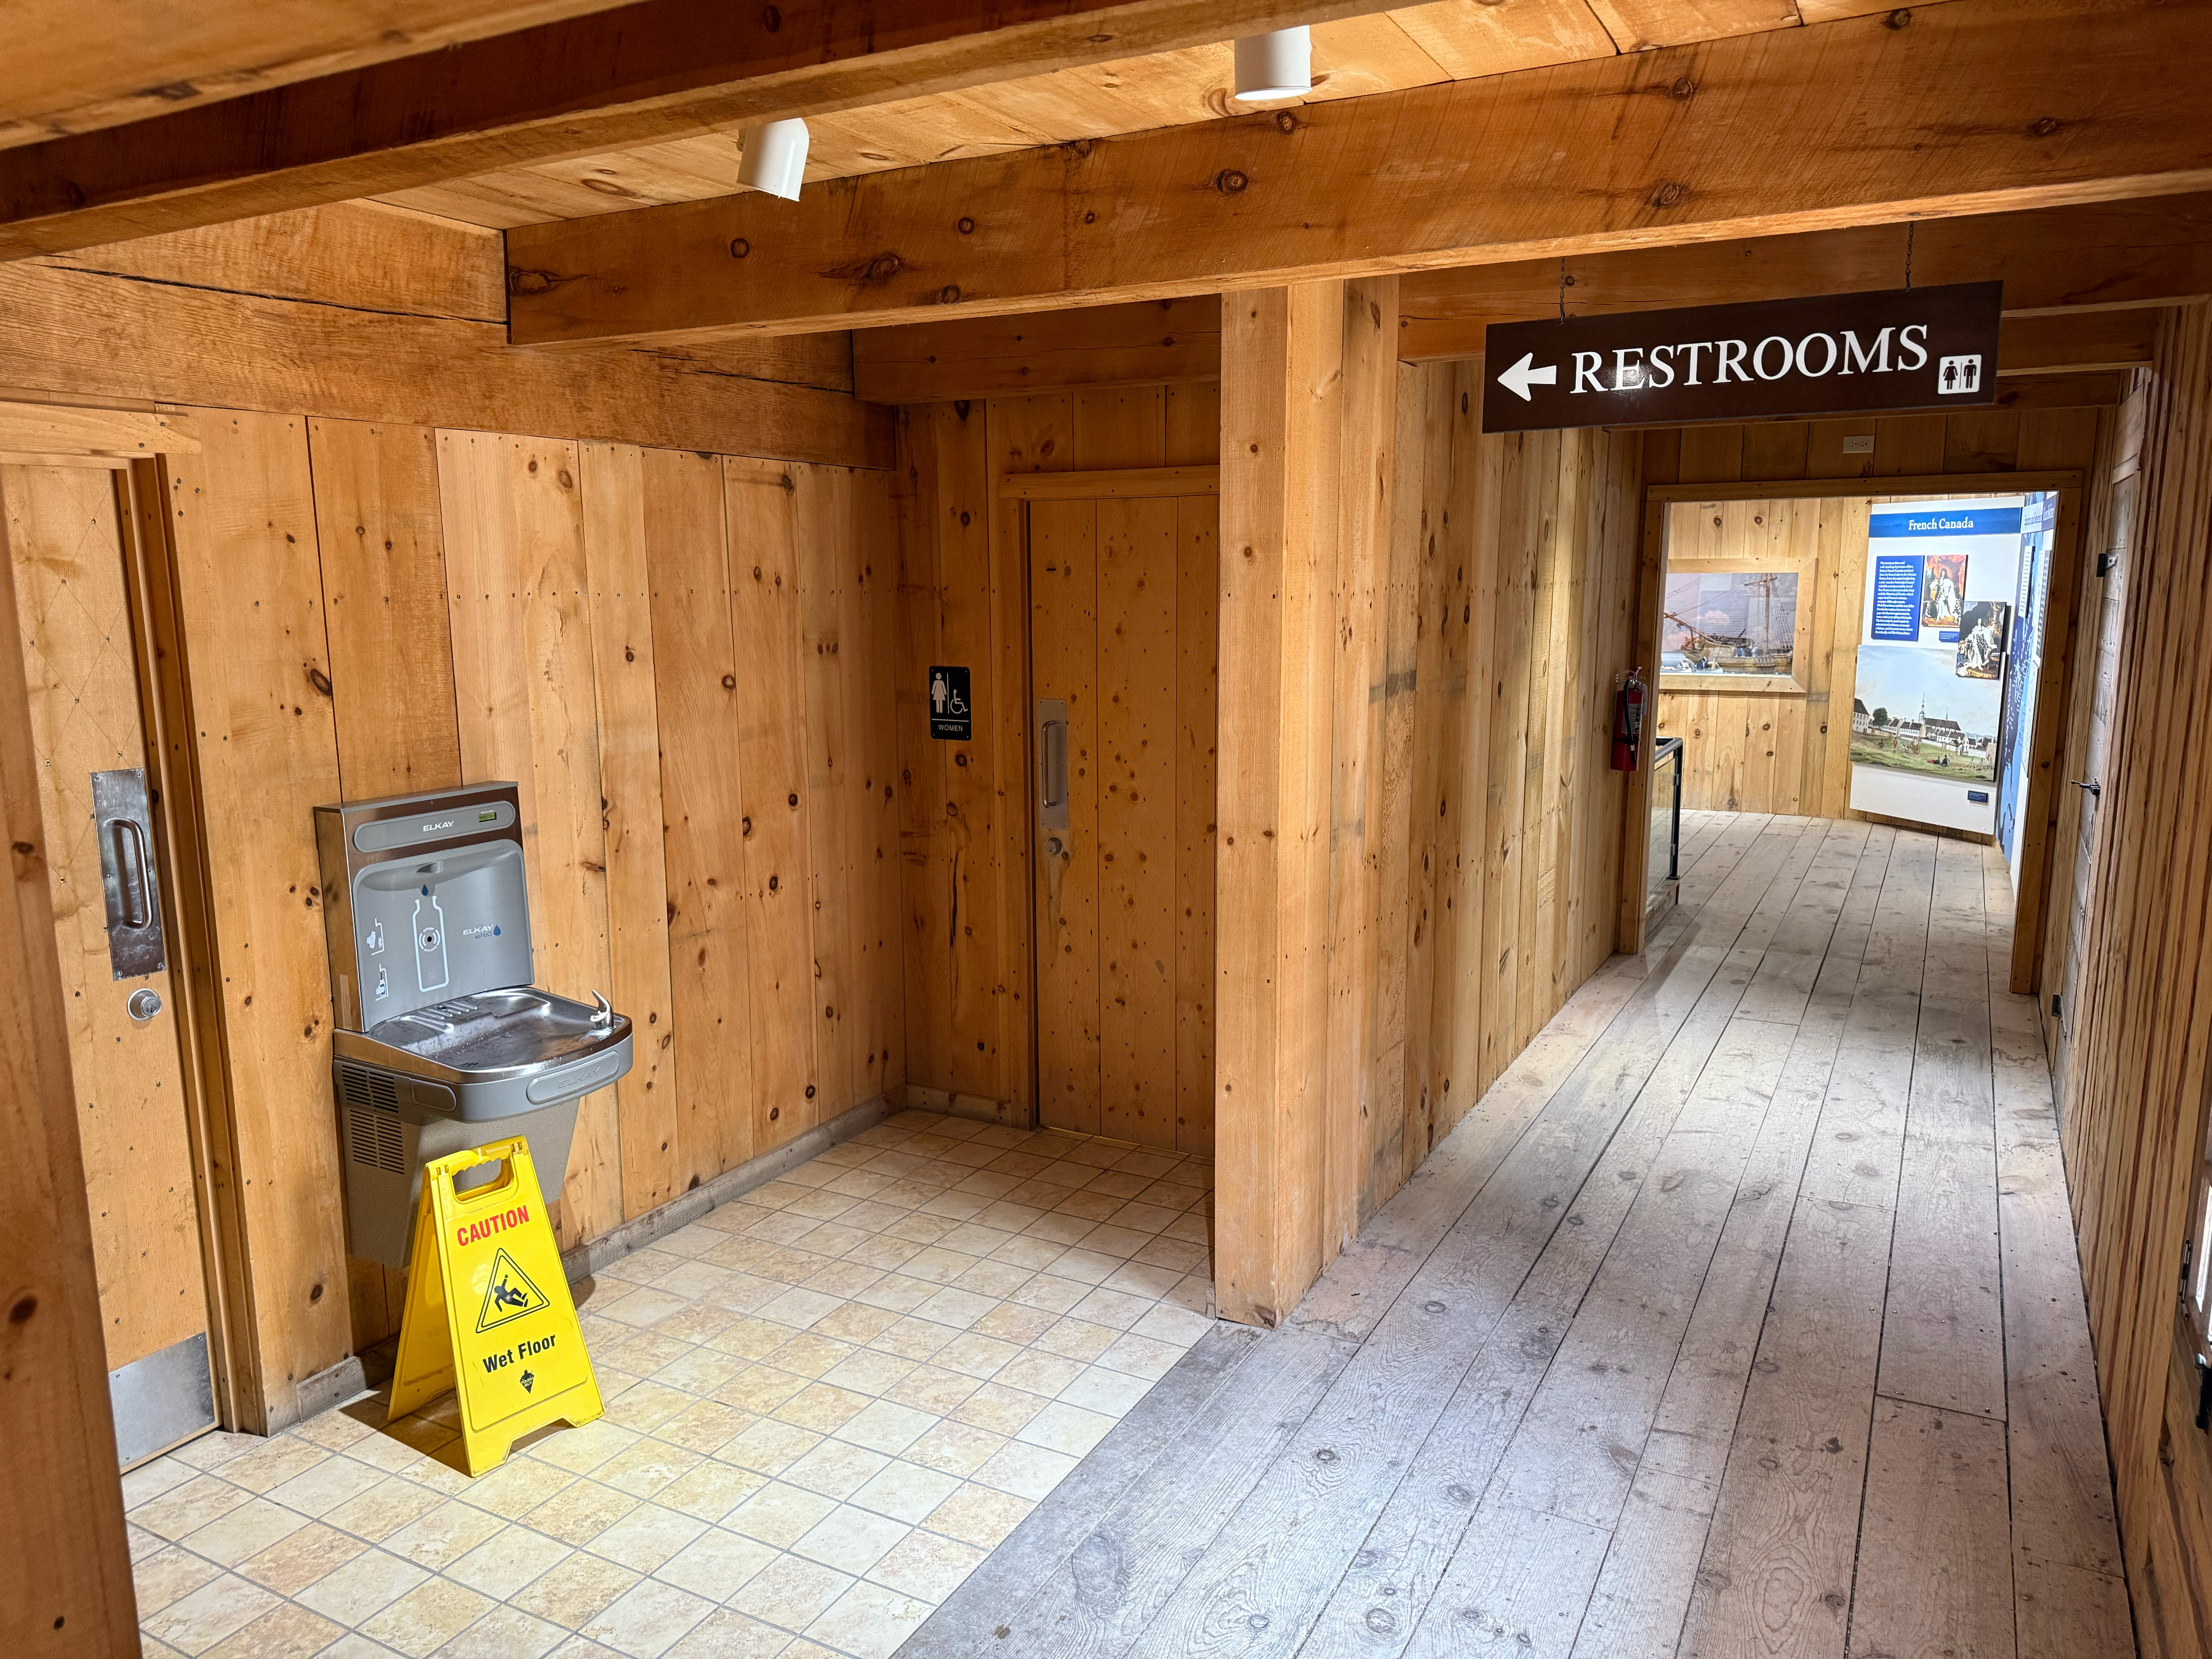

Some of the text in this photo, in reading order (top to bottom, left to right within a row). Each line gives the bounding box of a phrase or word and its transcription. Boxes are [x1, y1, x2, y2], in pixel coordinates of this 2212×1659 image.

[1570, 324, 1928, 395] RESTROOMS
[1908, 516, 1974, 530] French Canada
[423, 821, 454, 831] ELKAY
[463, 925, 493, 935] ELKAY
[558, 1066, 600, 1089] ELKAY
[457, 1205, 530, 1247] CAUTION
[483, 1334, 557, 1373] Wet Floor
